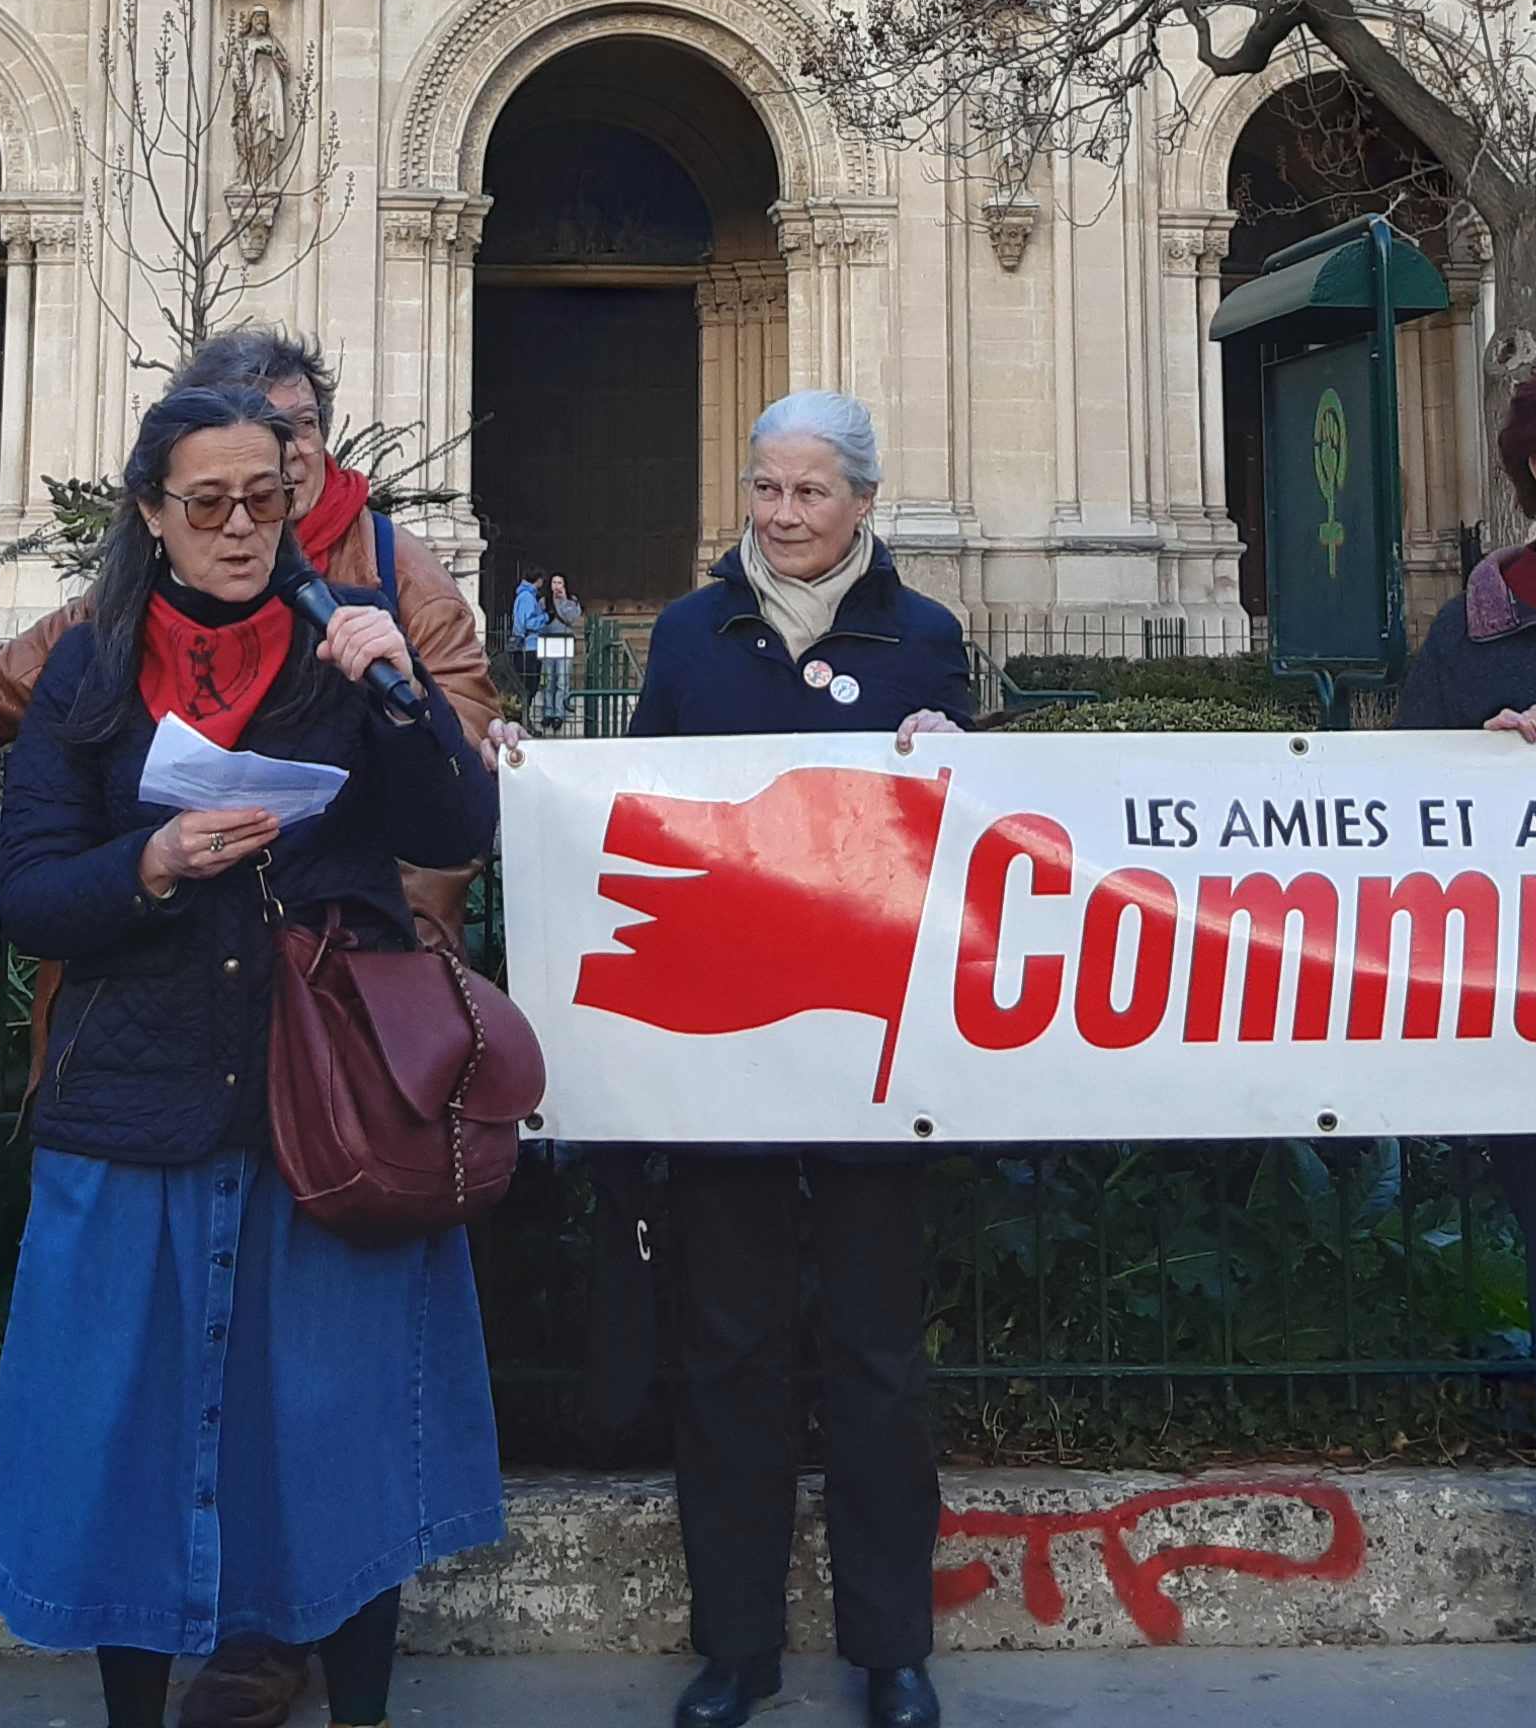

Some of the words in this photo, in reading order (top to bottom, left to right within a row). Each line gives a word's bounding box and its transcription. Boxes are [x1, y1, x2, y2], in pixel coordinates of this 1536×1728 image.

[1124, 797, 1199, 849] LES
[1220, 798, 1389, 849] AMIES
[1419, 799, 1474, 848] ET
